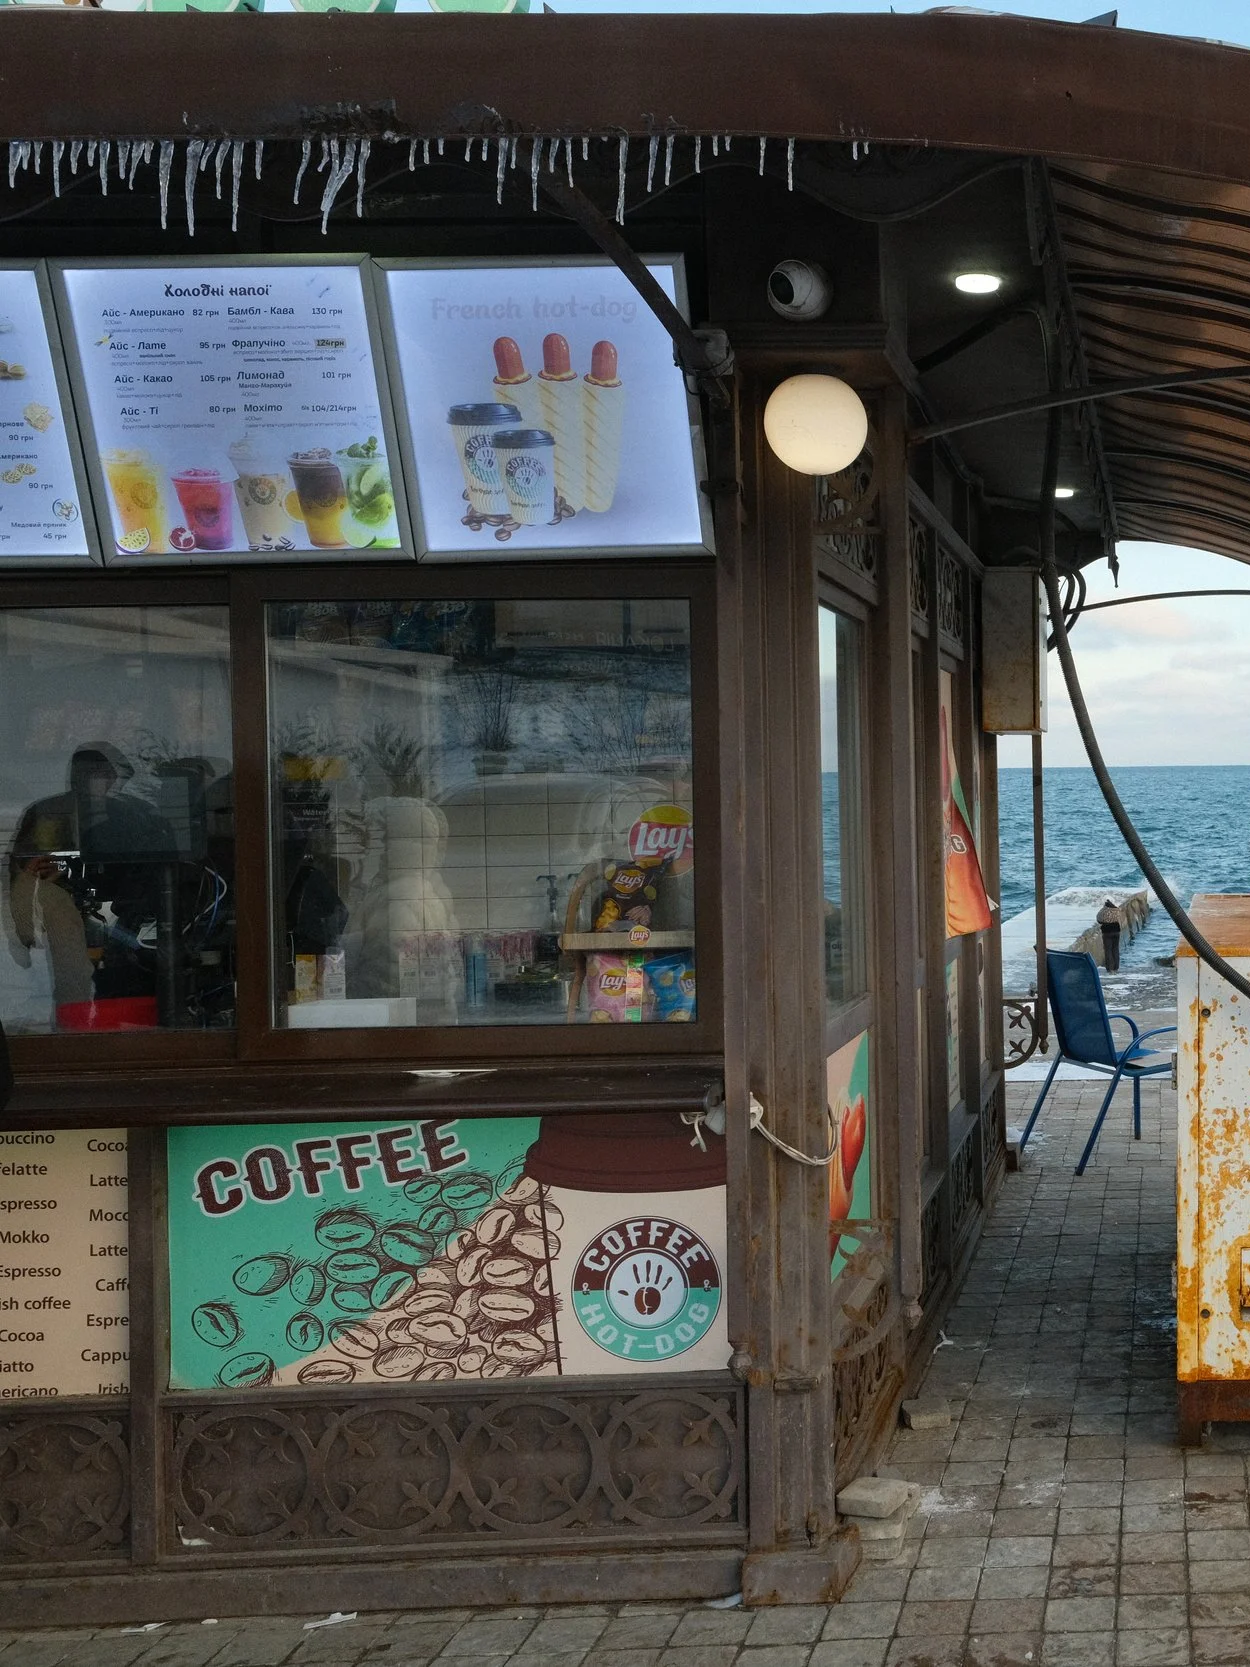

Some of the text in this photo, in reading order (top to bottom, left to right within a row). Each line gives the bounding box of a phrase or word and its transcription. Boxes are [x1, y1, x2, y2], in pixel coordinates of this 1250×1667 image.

[164, 283, 272, 297] Холодні напої
[102, 308, 120, 318] Айс
[129, 308, 185, 319] Американо
[192, 308, 203, 317] 82
[205, 309, 220, 318] грн
[227, 306, 261, 316] Бамбл
[270, 306, 295, 315] Кава
[312, 307, 327, 315] 130
[329, 308, 343, 317] грн
[431, 295, 638, 323] French hot-dog
[109, 341, 129, 351] Айс
[137, 341, 167, 350] Лате
[199, 341, 210, 349] 95
[212, 342, 226, 350] грн
[231, 339, 286, 349] Фрапучіно
[114, 374, 134, 384] Айс
[143, 374, 173, 384] Какао
[200, 374, 215, 382] 105
[217, 375, 231, 384] грн
[236, 370, 352, 381] Лимонад 101 грн
[120, 406, 140, 416] Айс
[209, 405, 220, 413] 80
[222, 406, 236, 415] грн
[243, 403, 283, 413] Мохіто
[21, 435, 34, 443] грн
[465, 434, 494, 454] COFF
[0, 453, 38, 461] мерикано
[41, 483, 54, 491] грн
[55, 533, 67, 541] грн
[194, 1118, 468, 1215] COFFEE
[89, 1173, 128, 1187] Latte
[0, 1230, 50, 1244] Mokko
[89, 1243, 128, 1257] Latte
[582, 1220, 710, 1272] COFFEE
[0, 1264, 62, 1281] Espresso
[23, 1296, 72, 1310] coffee
[86, 1313, 129, 1330] Espre
[580, 1302, 711, 1355] HOT-DOG
[0, 1329, 45, 1343] Cocoa
[0, 1385, 59, 1398] ericano
[98, 1382, 129, 1395] Irish
